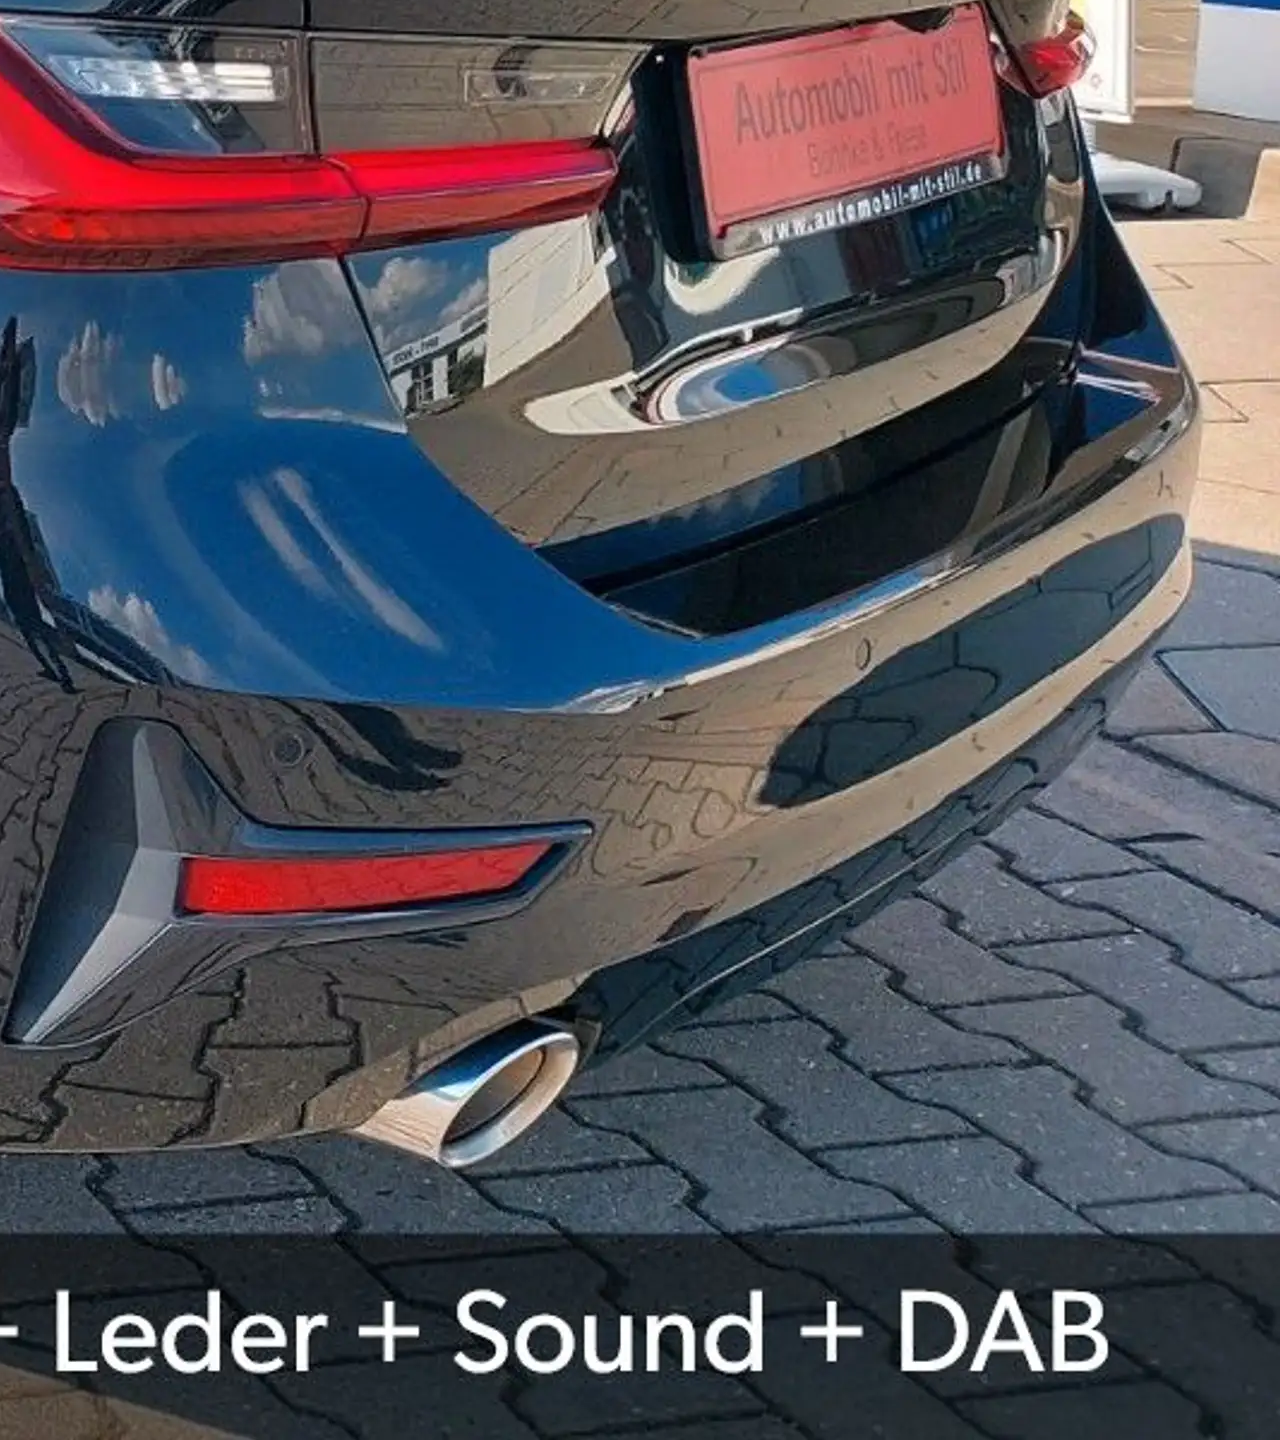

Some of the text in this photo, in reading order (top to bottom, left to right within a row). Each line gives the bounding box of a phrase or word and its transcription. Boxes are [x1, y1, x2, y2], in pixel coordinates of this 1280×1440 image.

[735, 38, 970, 145] Automobil mit Stil
[758, 161, 983, 245] www.automobil-mit-stil.de
